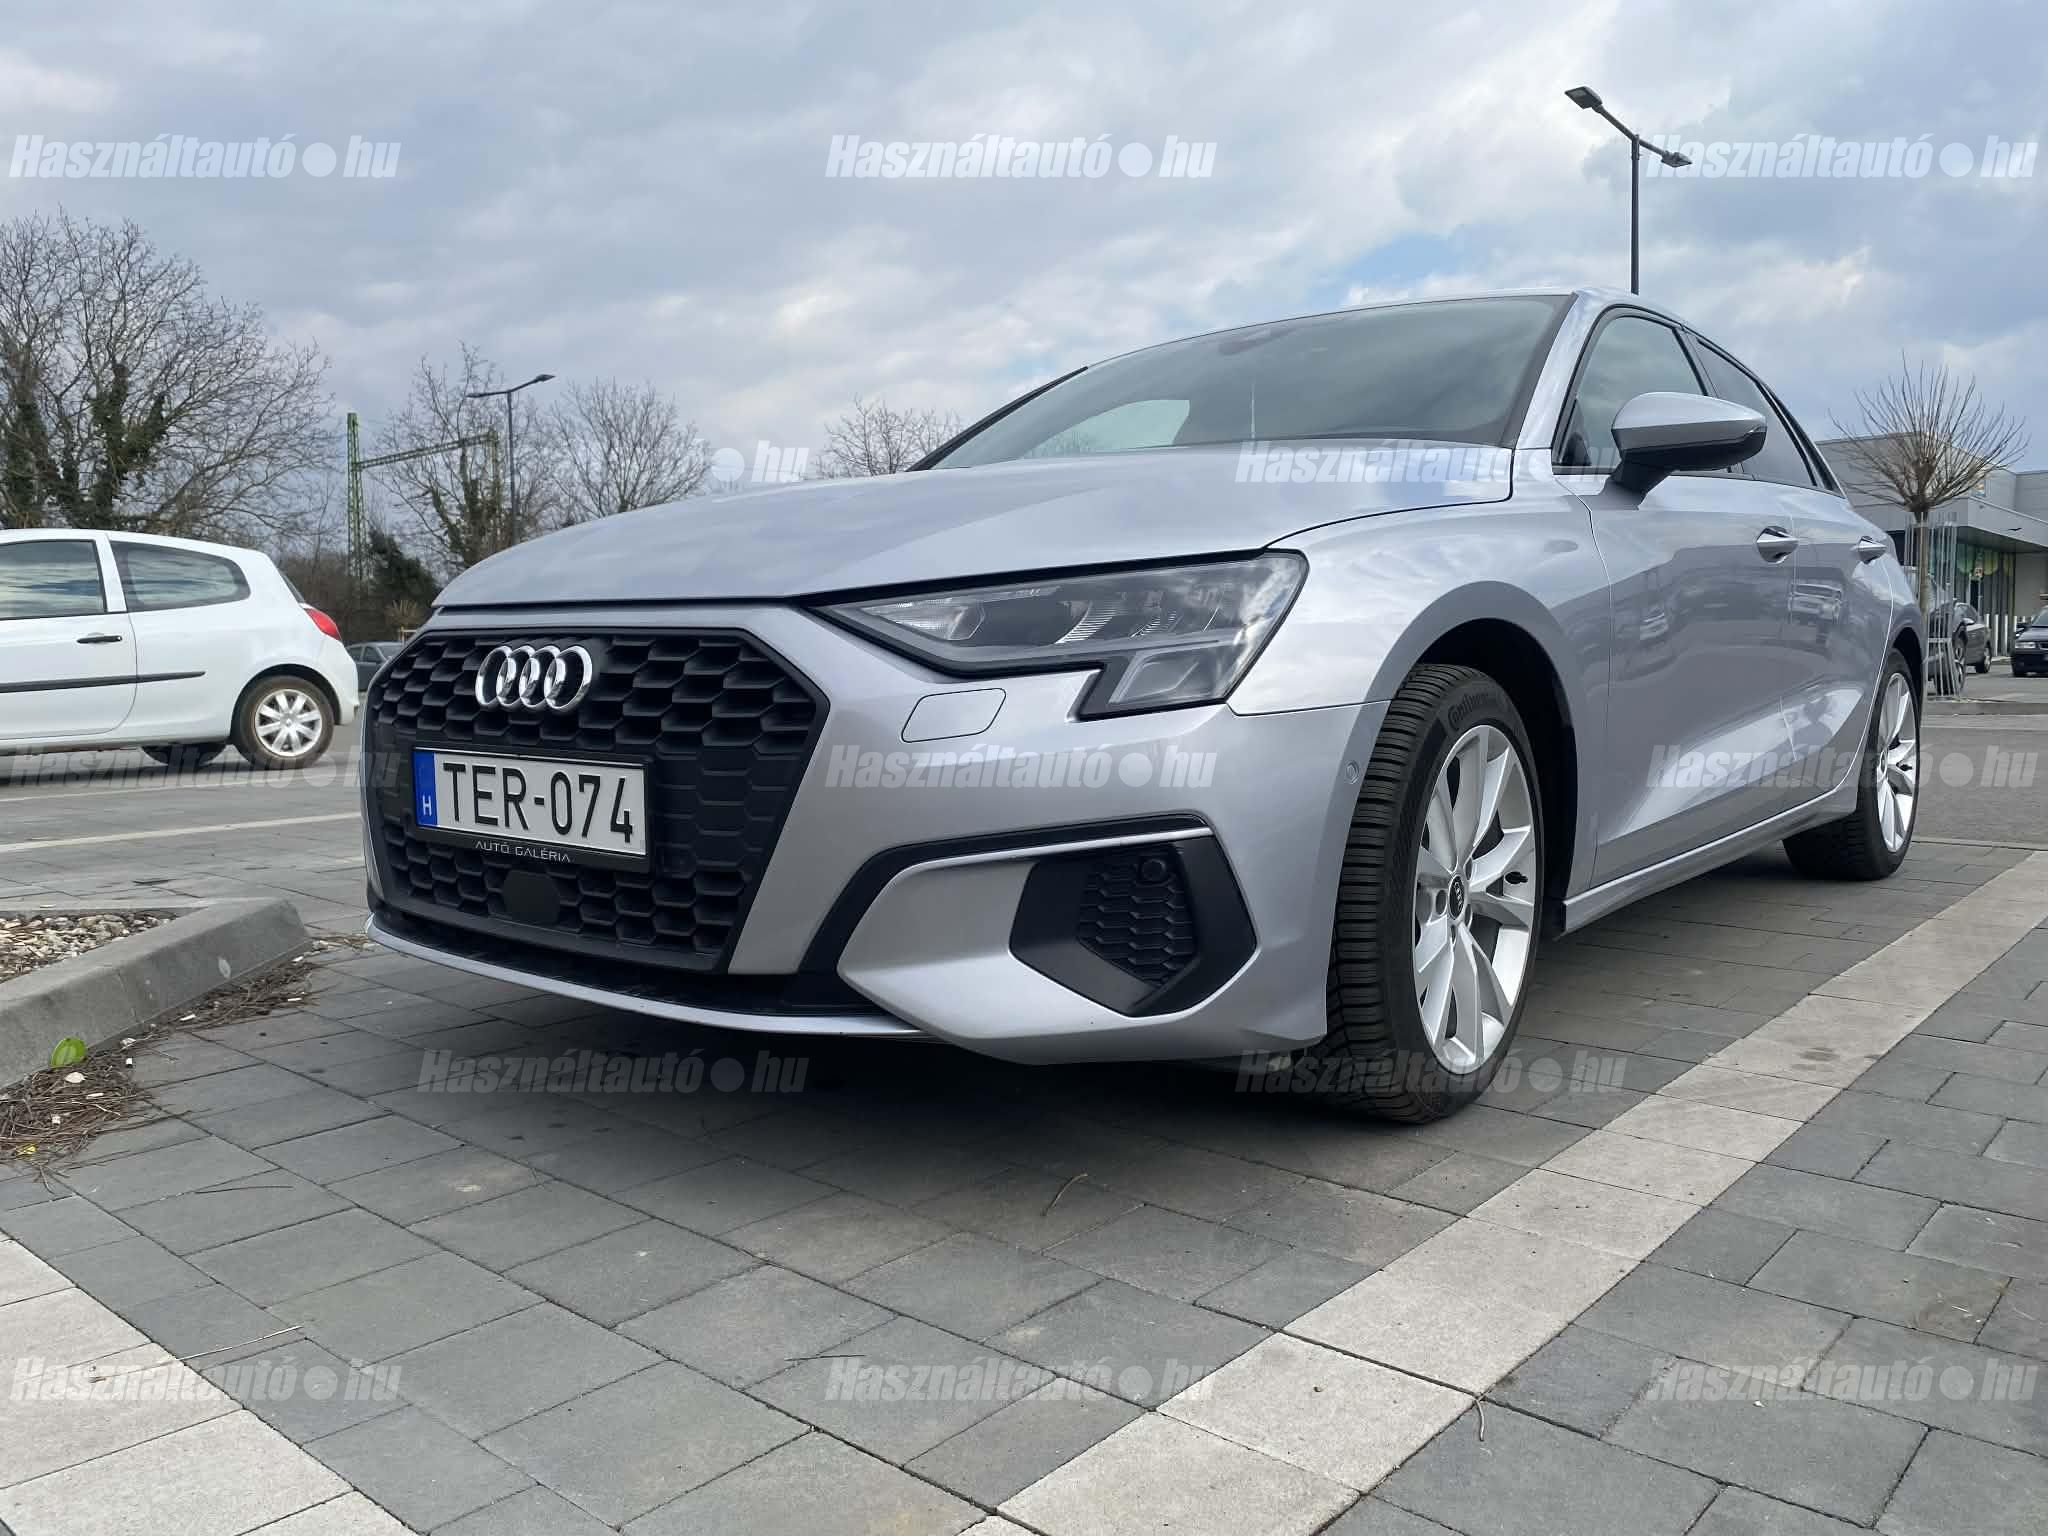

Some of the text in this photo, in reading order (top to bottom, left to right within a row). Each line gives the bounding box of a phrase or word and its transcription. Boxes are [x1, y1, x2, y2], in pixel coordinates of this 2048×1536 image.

[421, 794, 433, 817] H
[443, 763, 632, 843] TER-074
[475, 840, 571, 863] AUTÓ GALÉRIA
